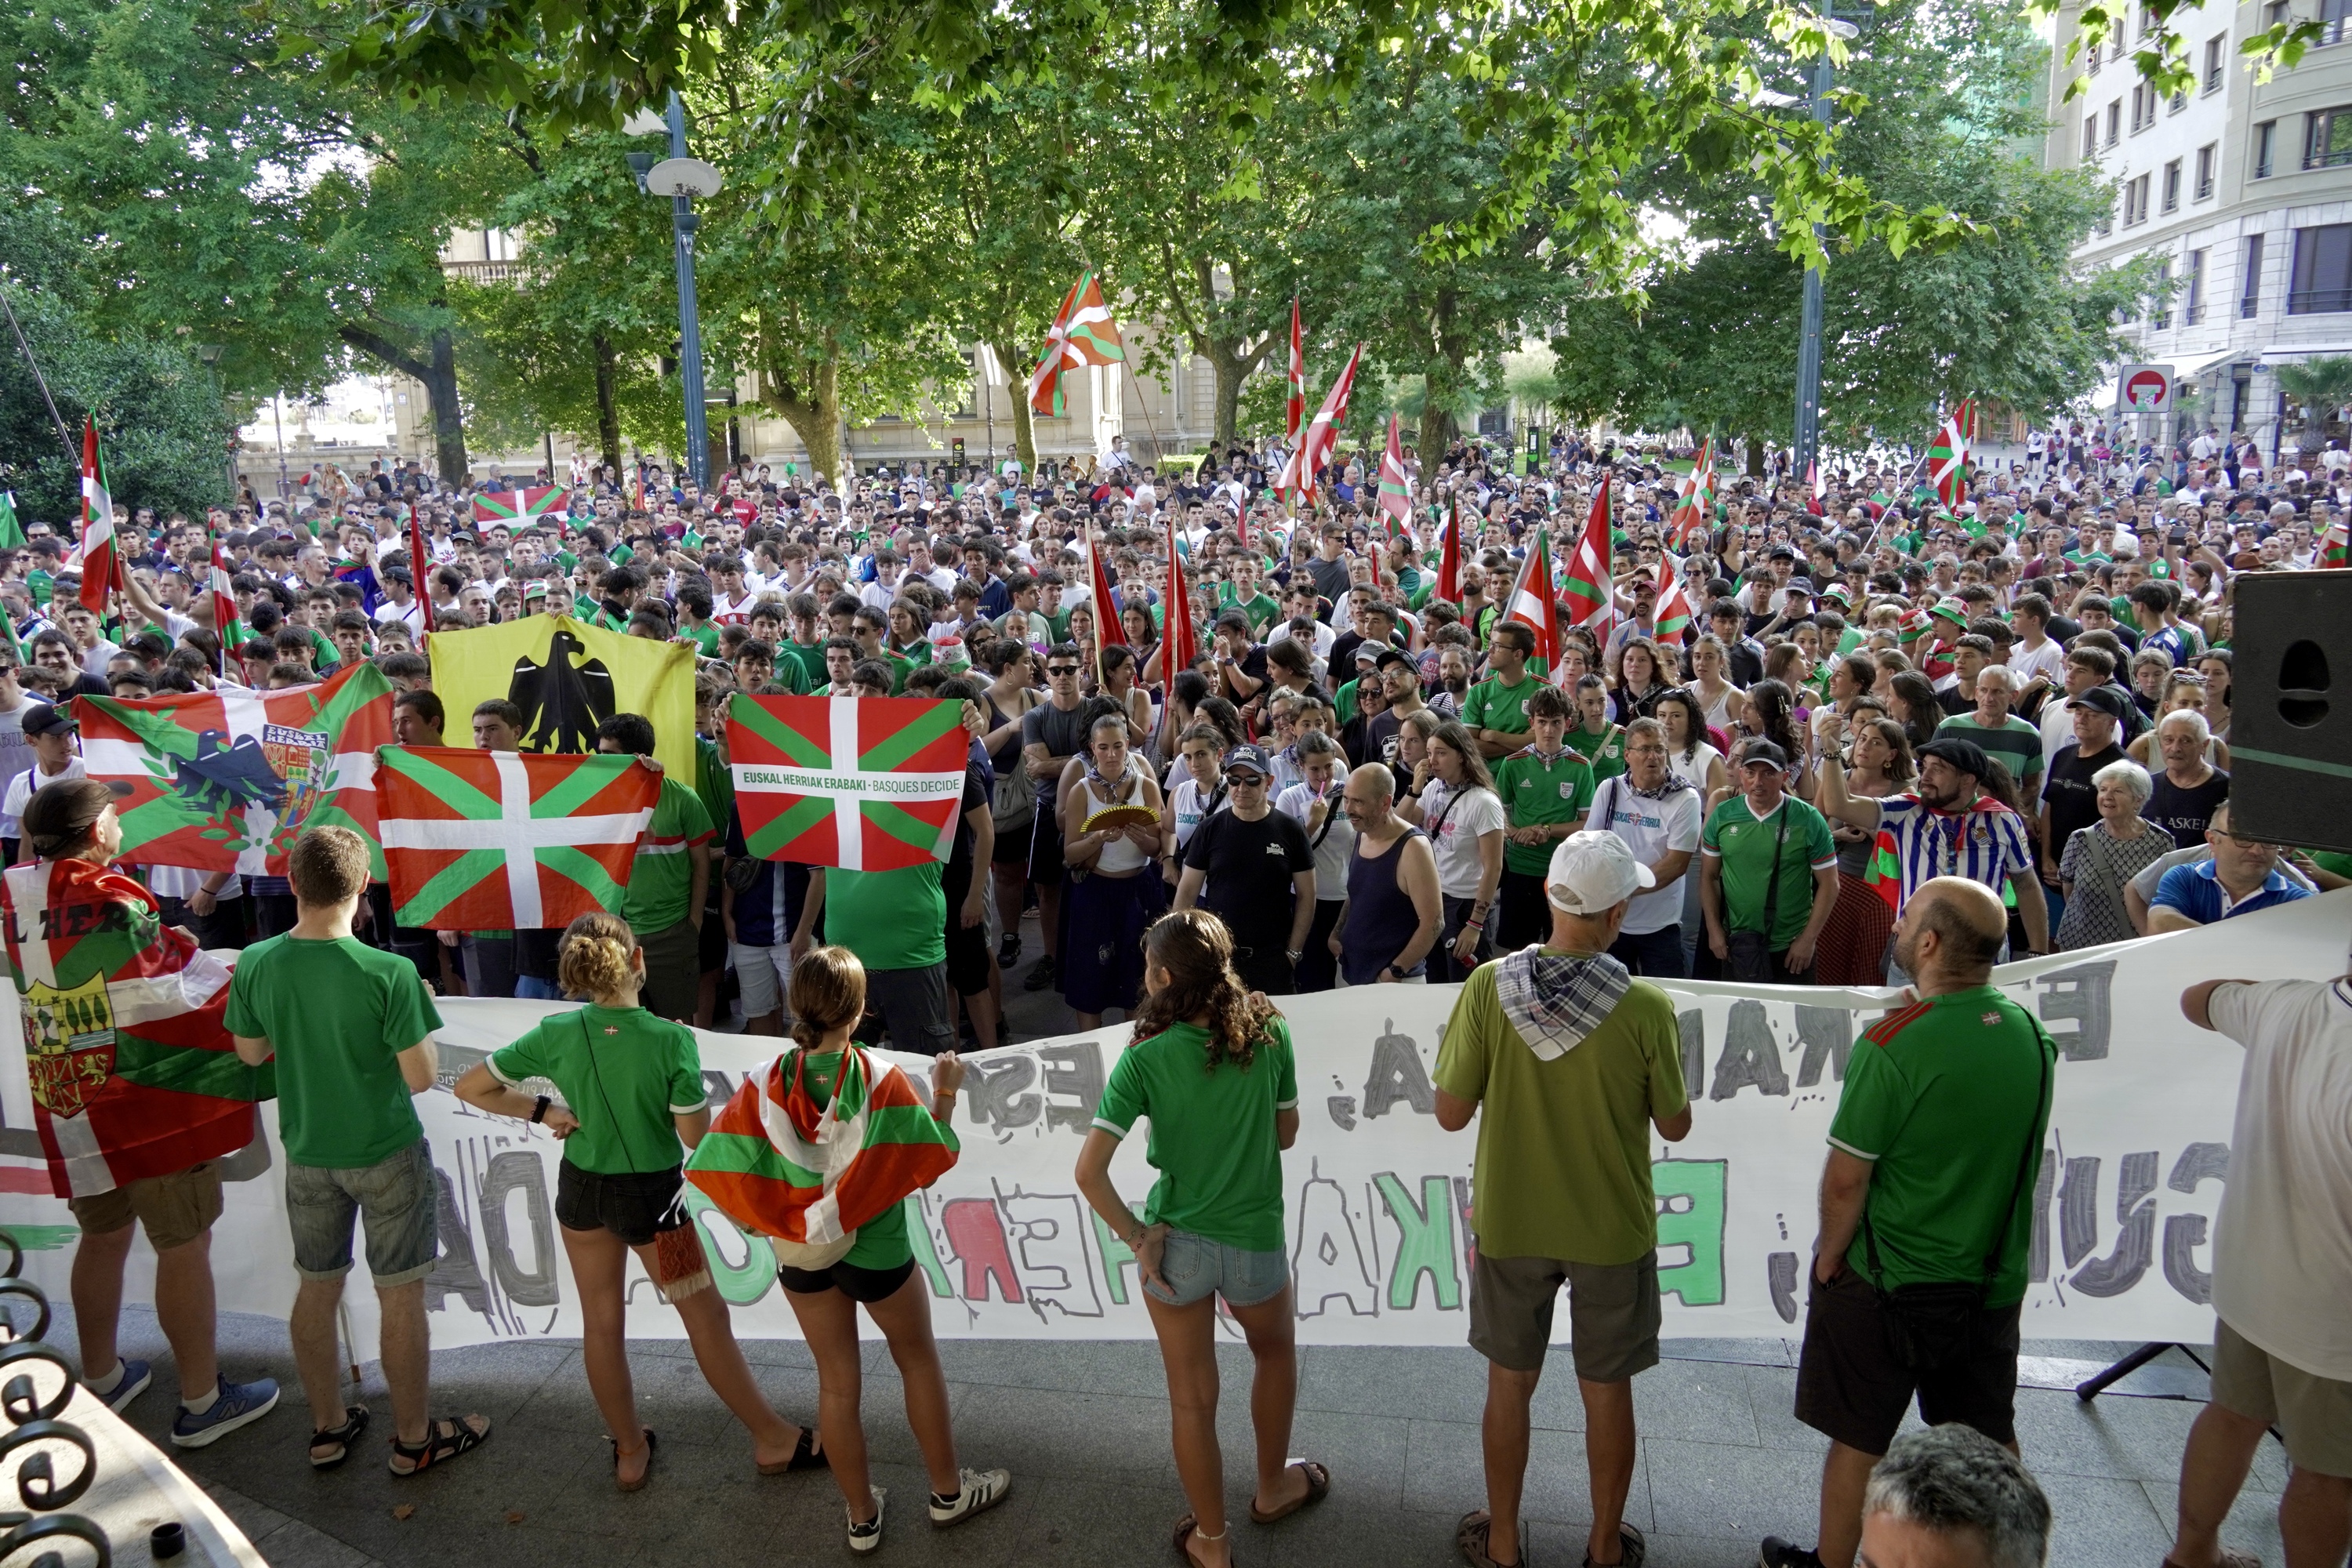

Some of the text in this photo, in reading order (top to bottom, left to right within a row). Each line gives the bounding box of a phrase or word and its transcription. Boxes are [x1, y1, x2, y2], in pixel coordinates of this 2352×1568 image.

[266, 733, 325, 749] HERRIA
[267, 726, 325, 741] EUSKAL
[743, 771, 782, 784] EUSKAL
[783, 774, 823, 789] HERRIAK
[824, 777, 867, 791] ERABAKI
[873, 780, 920, 793] BASQUES
[920, 779, 960, 793] DECIDE
[2168, 817, 2206, 830] ASKE!
